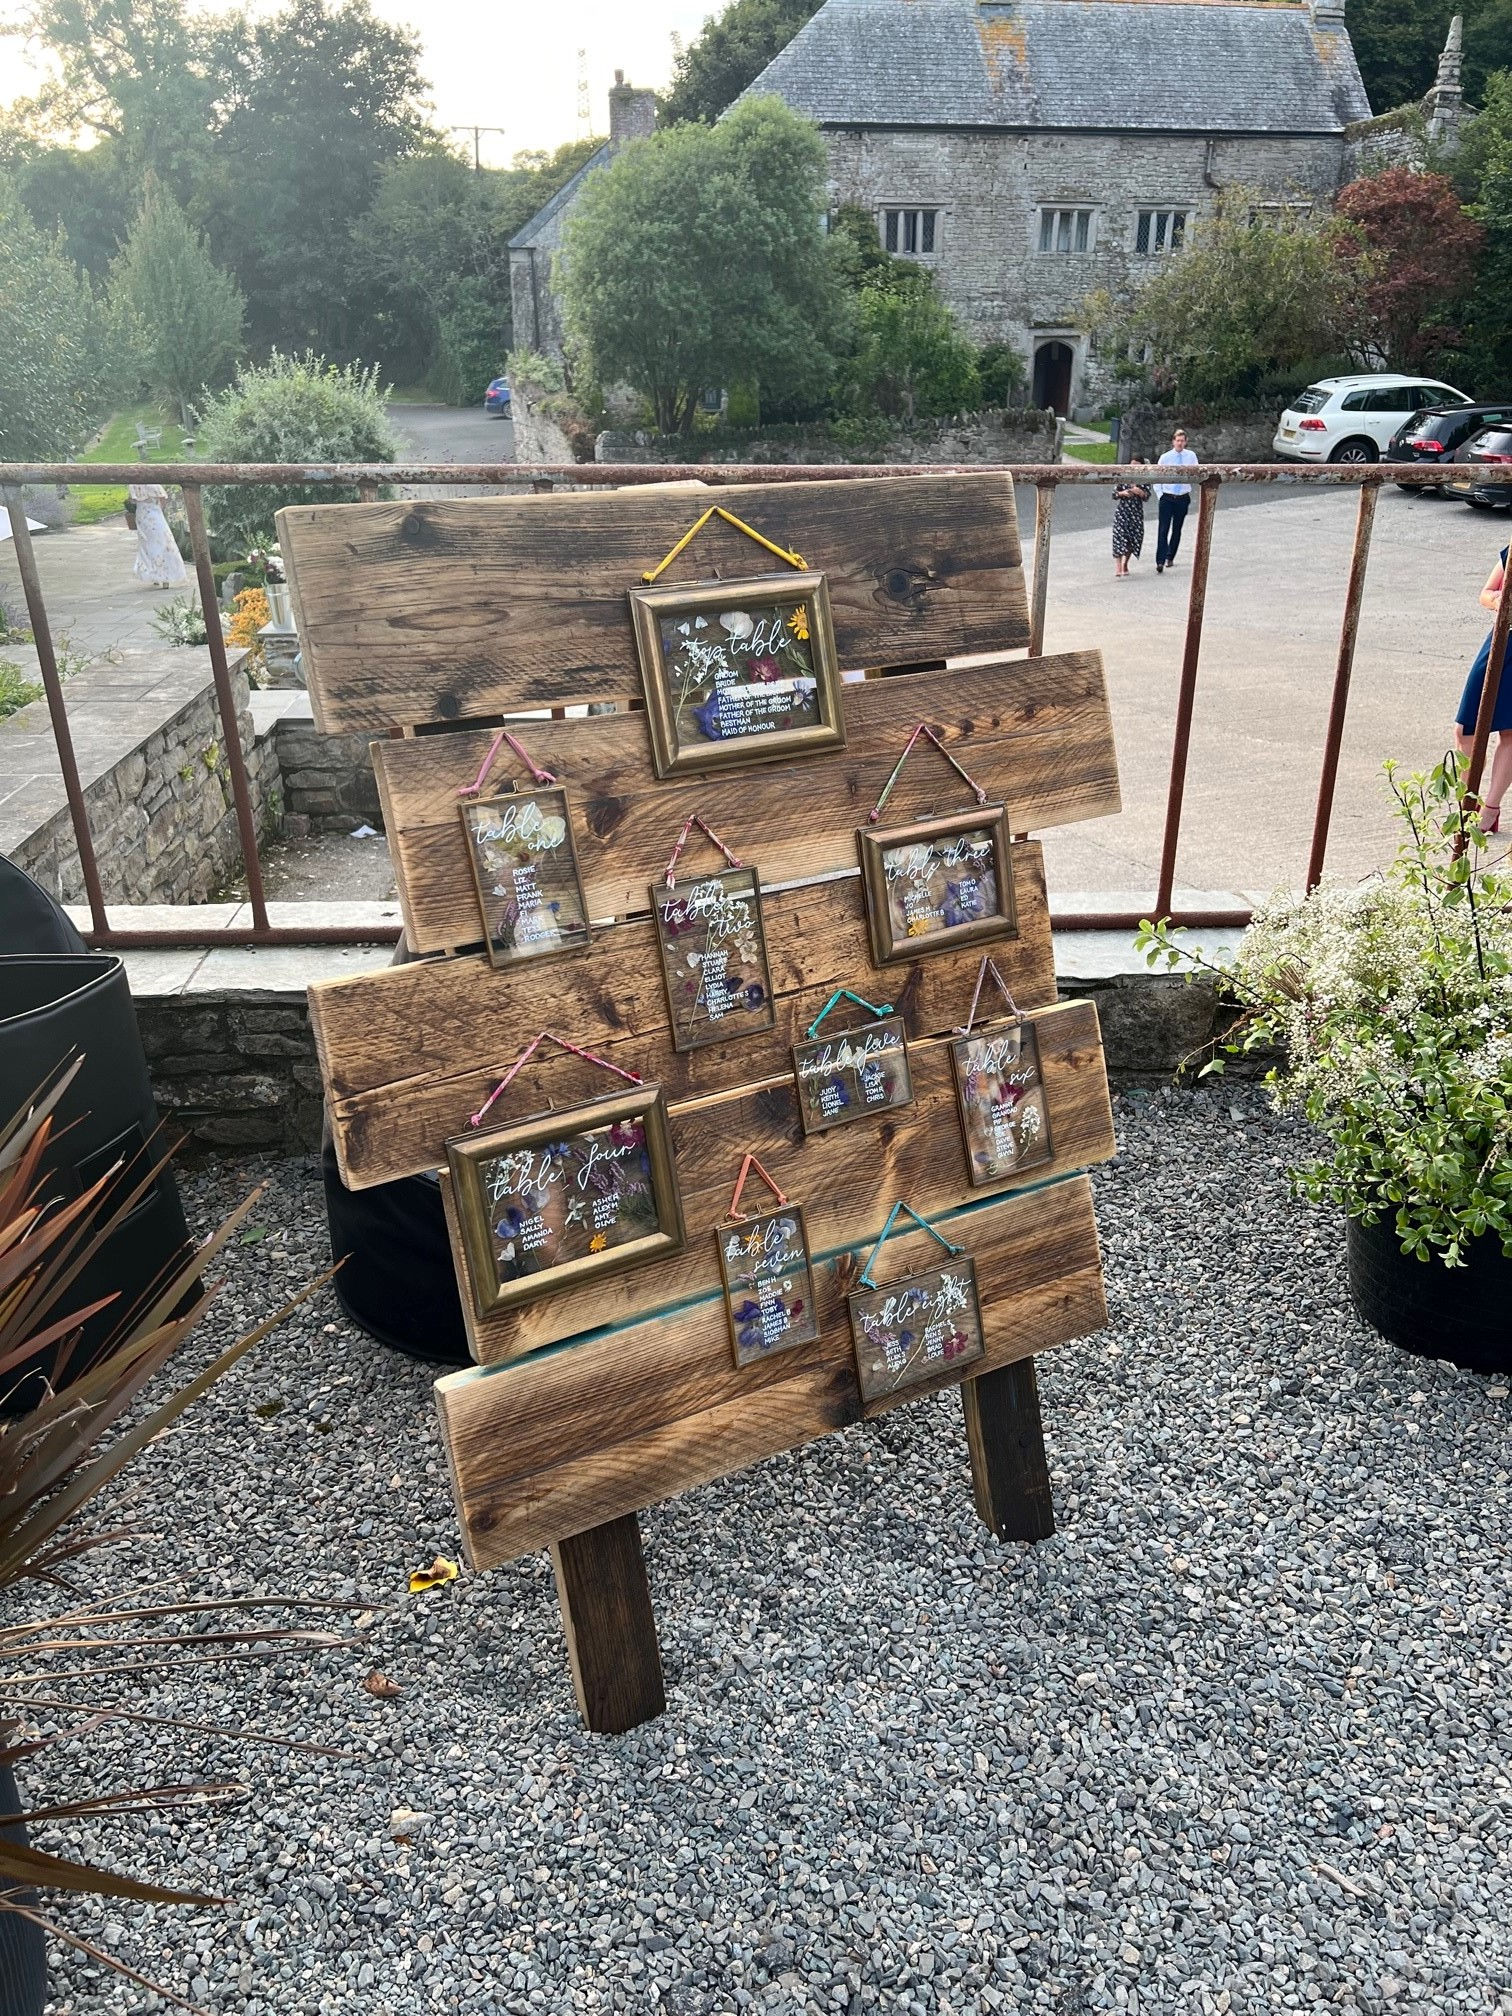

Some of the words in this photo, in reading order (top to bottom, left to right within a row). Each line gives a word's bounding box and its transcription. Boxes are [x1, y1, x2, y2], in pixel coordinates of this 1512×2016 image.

[681, 638, 726, 660] top
[725, 619, 791, 656] table
[714, 670, 738, 680] GROOM
[715, 679, 736, 688] BRIDE
[719, 702, 745, 712] MOTHER
[769, 696, 791, 704] GROOM
[719, 710, 745, 720] FATHER
[768, 704, 791, 713] GROOM
[720, 717, 750, 727] BESTMAN
[721, 727, 738, 736] MAID
[748, 722, 775, 732] HONOUR
[471, 802, 544, 844] table
[528, 836, 564, 851] one
[886, 844, 940, 880] table
[943, 838, 989, 867] three
[513, 865, 536, 876] ROSIE
[514, 877, 528, 885] LIZ
[959, 880, 971, 888] TOM
[515, 883, 536, 893] MATT
[960, 886, 978, 895] LAURA
[516, 890, 543, 901] FRANK
[904, 891, 932, 903] MICHELLE
[518, 899, 543, 910] MARIA
[661, 883, 724, 922] table
[906, 907, 924, 916] JAMES
[715, 917, 755, 937] two
[701, 950, 728, 961] HANNAH
[703, 966, 725, 976] CLARA
[704, 973, 726, 983] ELLIOT
[705, 982, 724, 990] LYDIA
[707, 992, 744, 1006] CHARLOTTE
[708, 1002, 733, 1014] HELENA
[709, 1012, 724, 1021] SAM
[799, 1039, 853, 1078] table
[857, 1033, 899, 1076] five
[962, 1039, 1016, 1076] table
[864, 1071, 885, 1081] JACKIE
[1010, 1065, 1035, 1085] six
[865, 1081, 879, 1089] LISA
[820, 1086, 836, 1096] JUDY
[865, 1088, 879, 1096] TOM
[820, 1093, 840, 1102] KEITH
[866, 1093, 885, 1103] CHRIS
[822, 1099, 844, 1109] LIONEL
[822, 1107, 839, 1117] JANE
[487, 1154, 563, 1201] table
[577, 1142, 636, 1190] four
[592, 1193, 619, 1207] ASHER
[519, 1215, 544, 1229] NIGEL
[594, 1211, 611, 1222] AMY
[520, 1222, 544, 1235] SALLY
[595, 1217, 616, 1229] OLIVE
[522, 1227, 553, 1244] AMANDA
[724, 1219, 784, 1262] table
[523, 1239, 547, 1251] DARYL
[754, 1248, 803, 1273] seven
[757, 1278, 770, 1288] BEN
[760, 1288, 783, 1302] MADDIE
[760, 1298, 775, 1309] FINN
[860, 1291, 915, 1333] table
[922, 1276, 971, 1319] eight
[761, 1304, 778, 1315] TOBY
[762, 1311, 786, 1323] RACHEL
[763, 1319, 782, 1331] JAMES
[764, 1323, 791, 1338] SIOBHAN
[925, 1321, 946, 1334] RACHEL
[764, 1334, 780, 1345] MIKE
[926, 1335, 945, 1346] JENNY
[927, 1343, 943, 1353] BRAD
